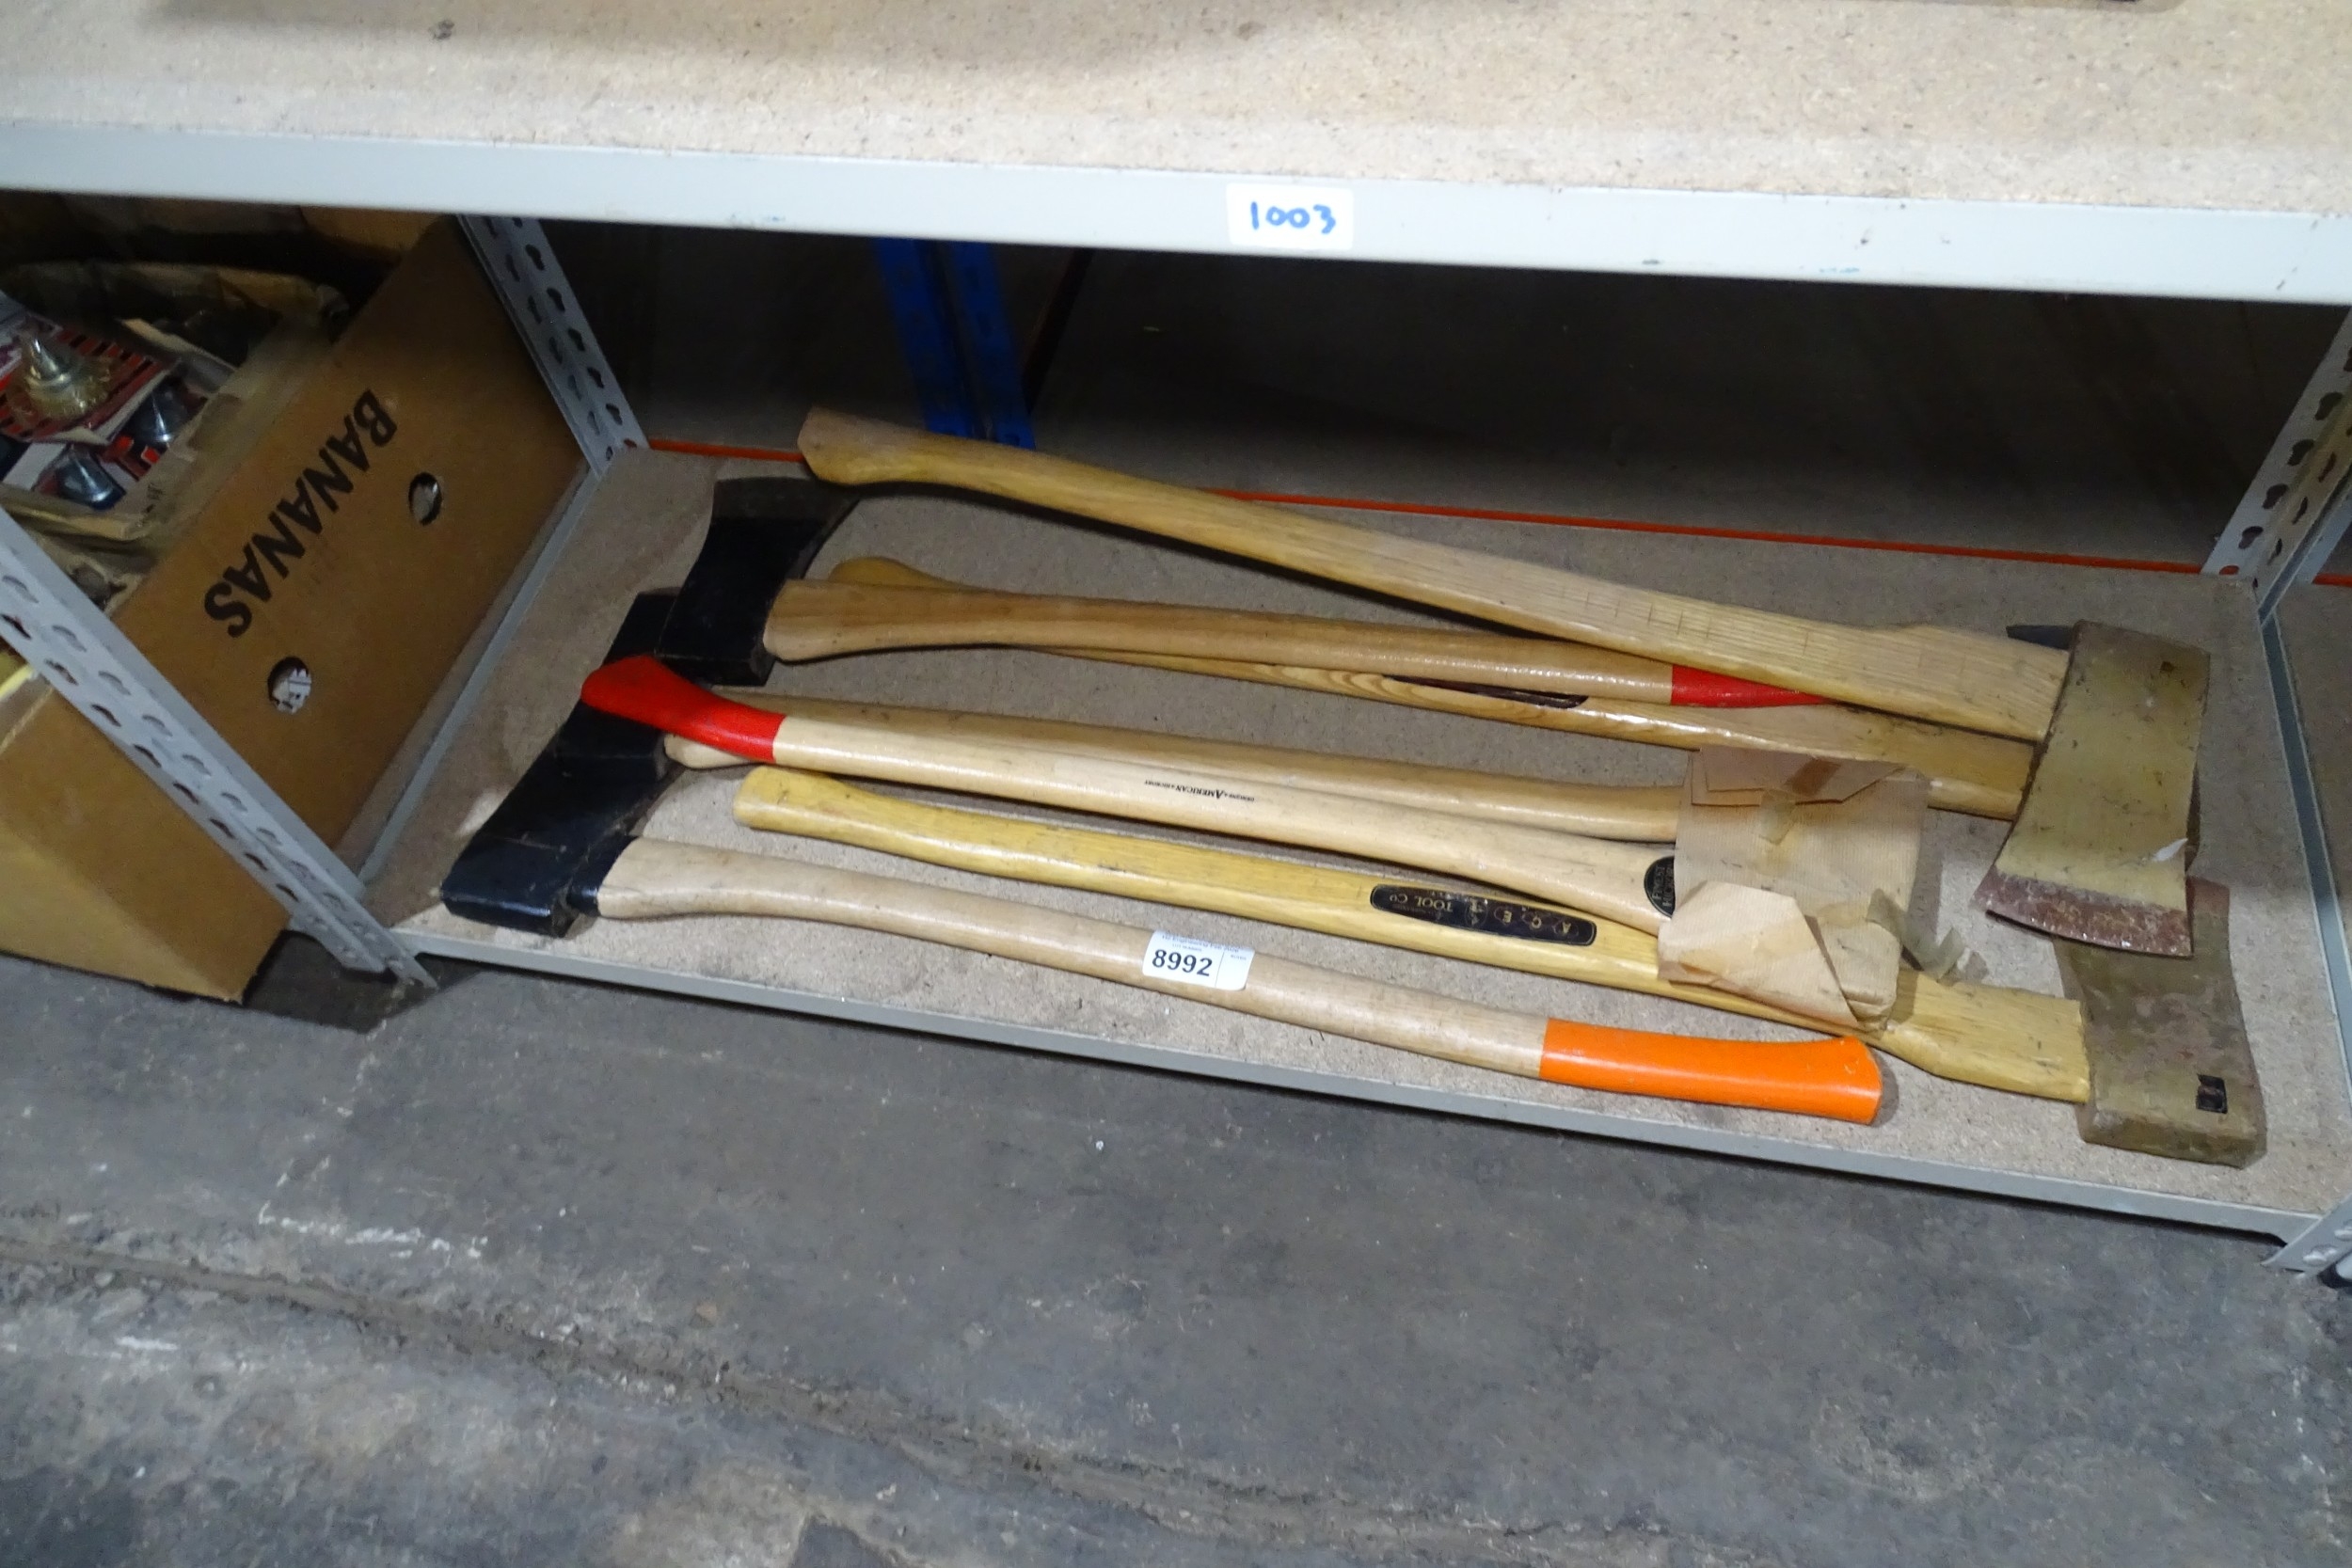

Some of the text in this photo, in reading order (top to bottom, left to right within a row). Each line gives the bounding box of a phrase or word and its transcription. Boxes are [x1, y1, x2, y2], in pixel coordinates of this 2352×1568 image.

[1250, 200, 1337, 235] 1003
[203, 388, 399, 639] BANANAS
[1175, 784, 1226, 800] AMERICAN
[1415, 896, 1454, 912] TOOL
[1152, 948, 1214, 977] 8992
